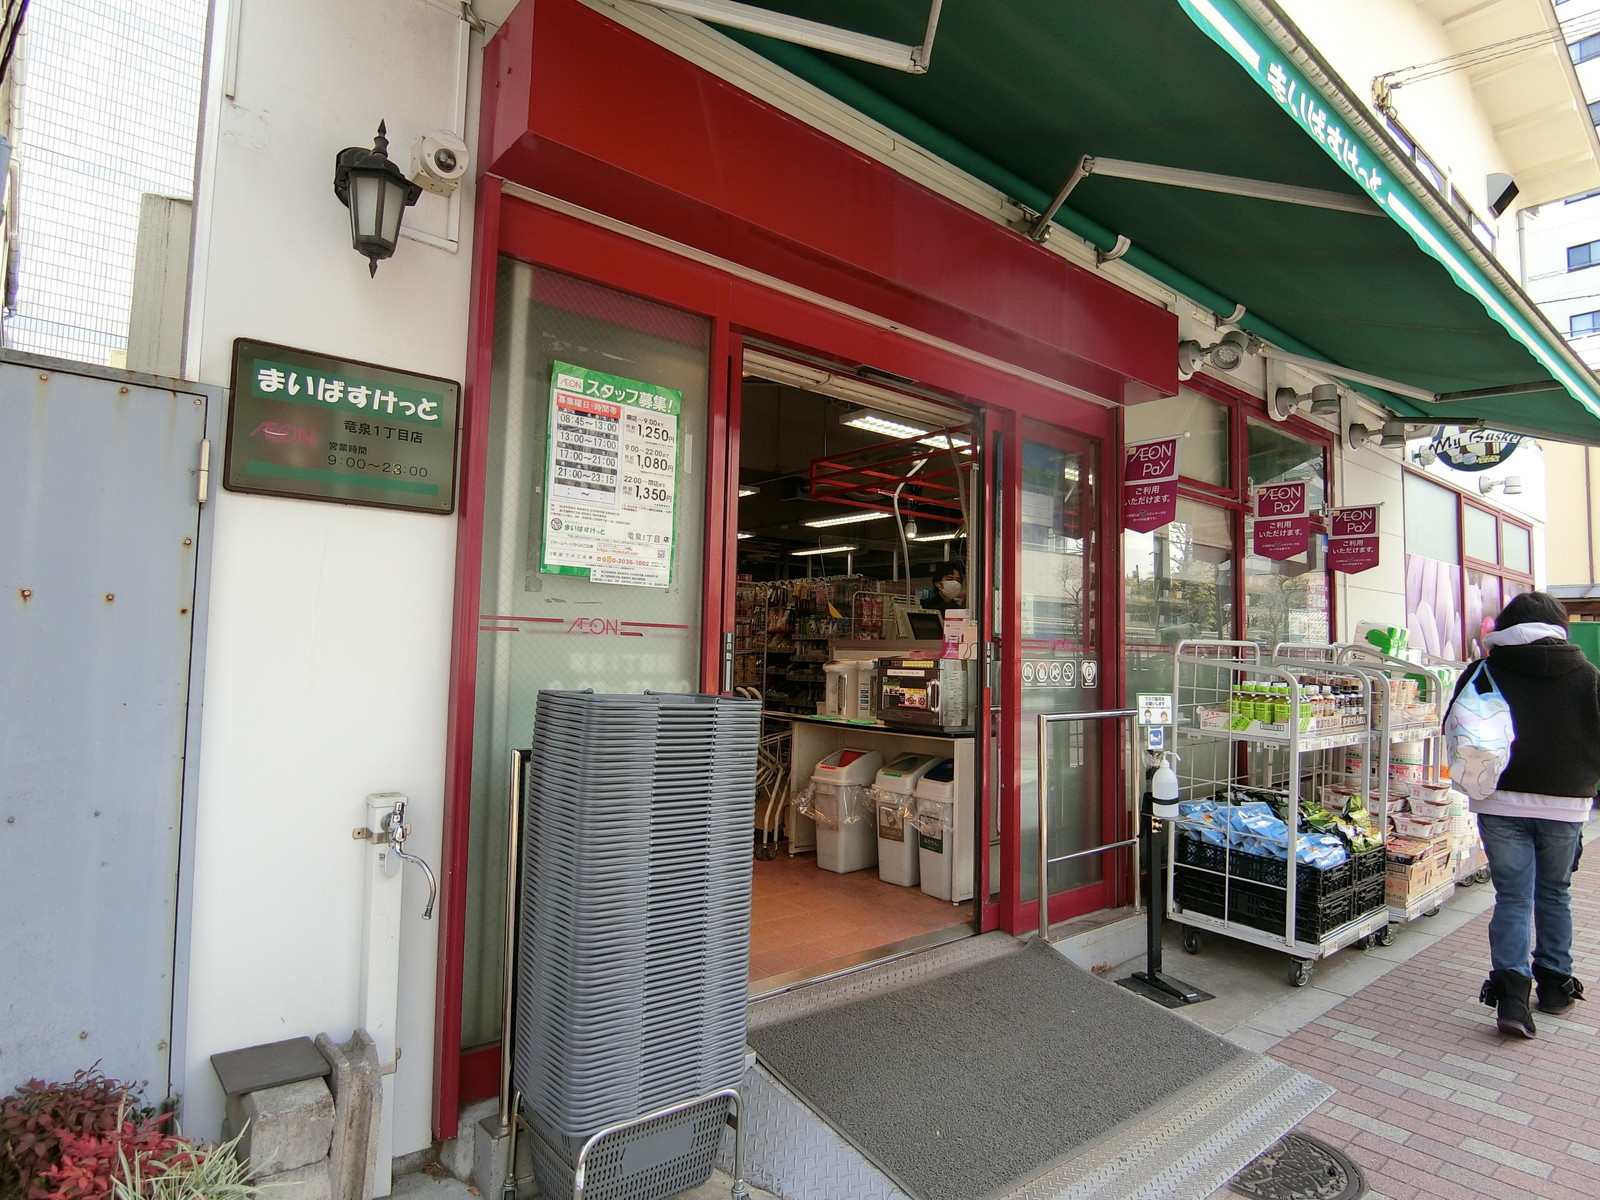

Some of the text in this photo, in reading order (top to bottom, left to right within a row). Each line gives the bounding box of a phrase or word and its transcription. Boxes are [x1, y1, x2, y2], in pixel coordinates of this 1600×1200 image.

[1266, 61, 1386, 205] まいばすけっと
[257, 367, 439, 421] まいばすけっと
[343, 419, 424, 444] 竜泉1丁目店
[328, 441, 368, 455] 営業時間
[1428, 436, 1461, 455] My
[1135, 485, 1160, 496] ご利用
[1269, 520, 1292, 529] ご利用
[1258, 528, 1303, 538] いただけます。
[1342, 539, 1364, 547] ご利用
[602, 556, 650, 567] 00-2036-1002
